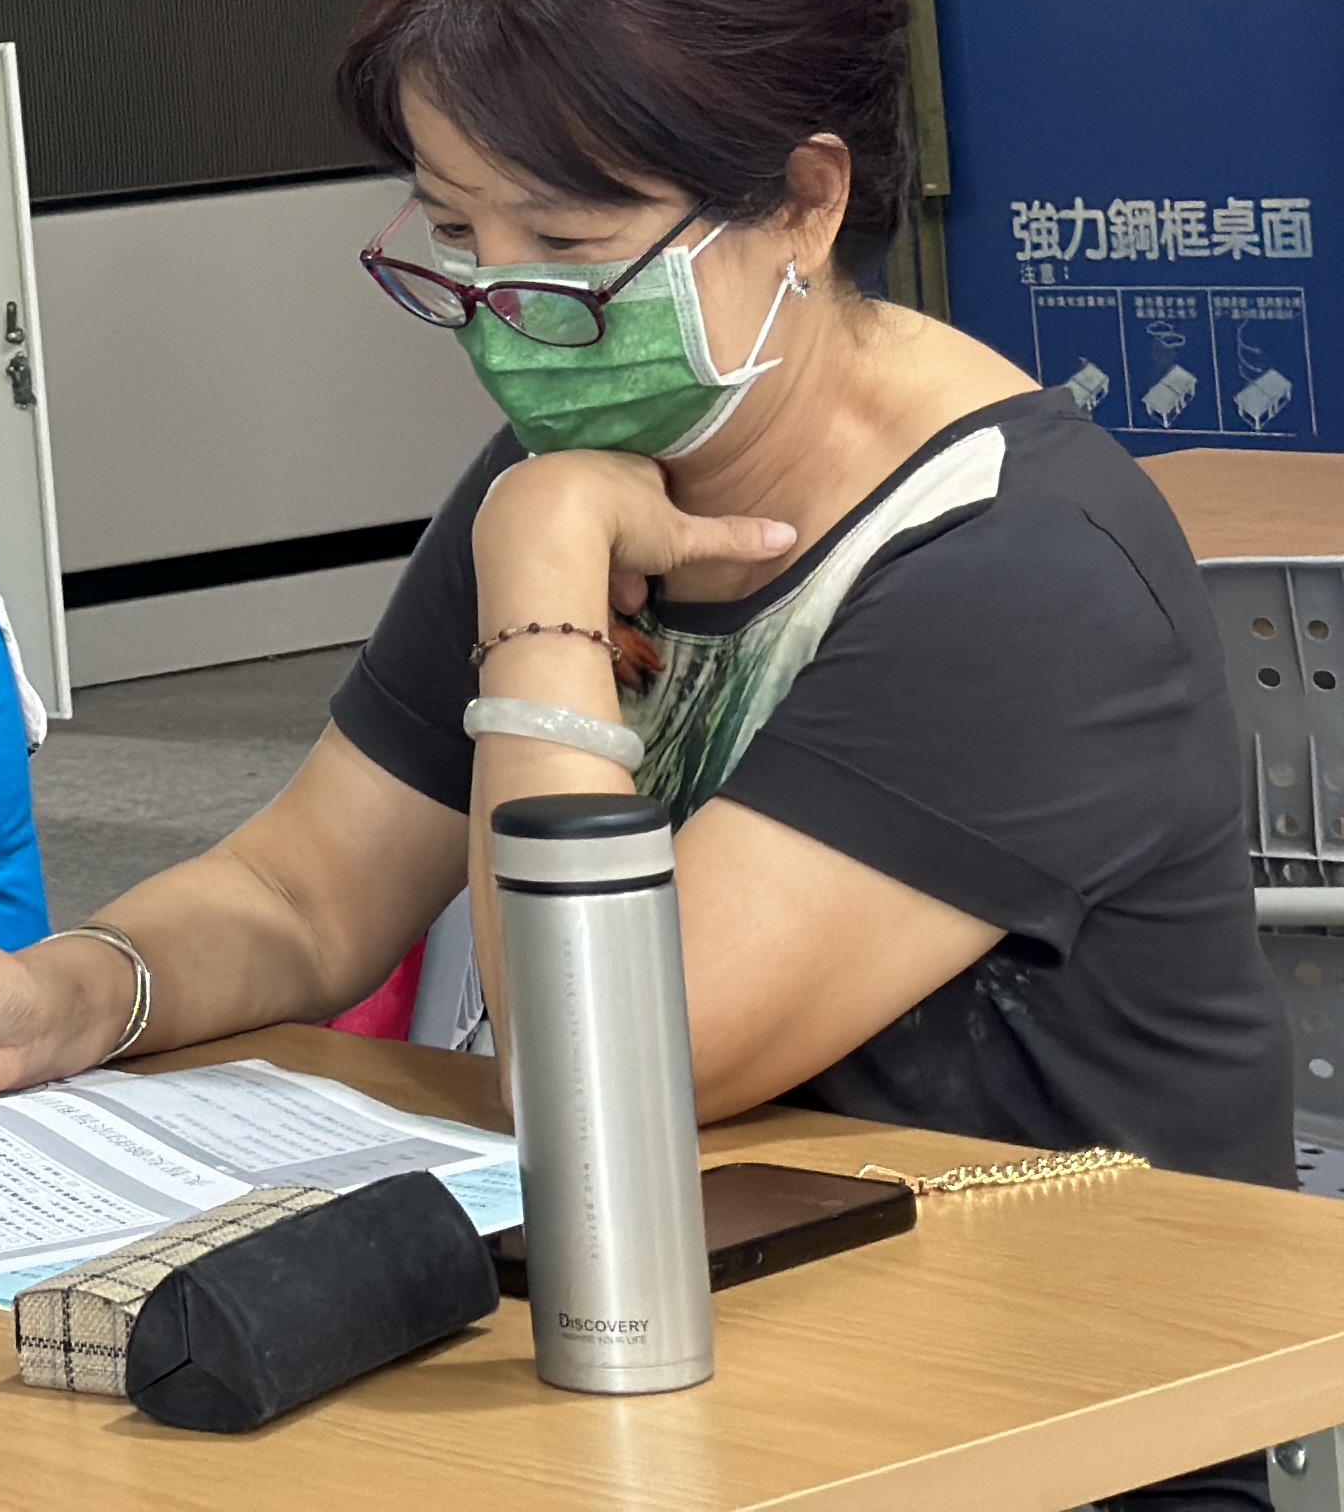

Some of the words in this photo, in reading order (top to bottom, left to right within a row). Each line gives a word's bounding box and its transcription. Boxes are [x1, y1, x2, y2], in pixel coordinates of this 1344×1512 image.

[1010, 196, 1314, 262] 強力鋼框桌面
